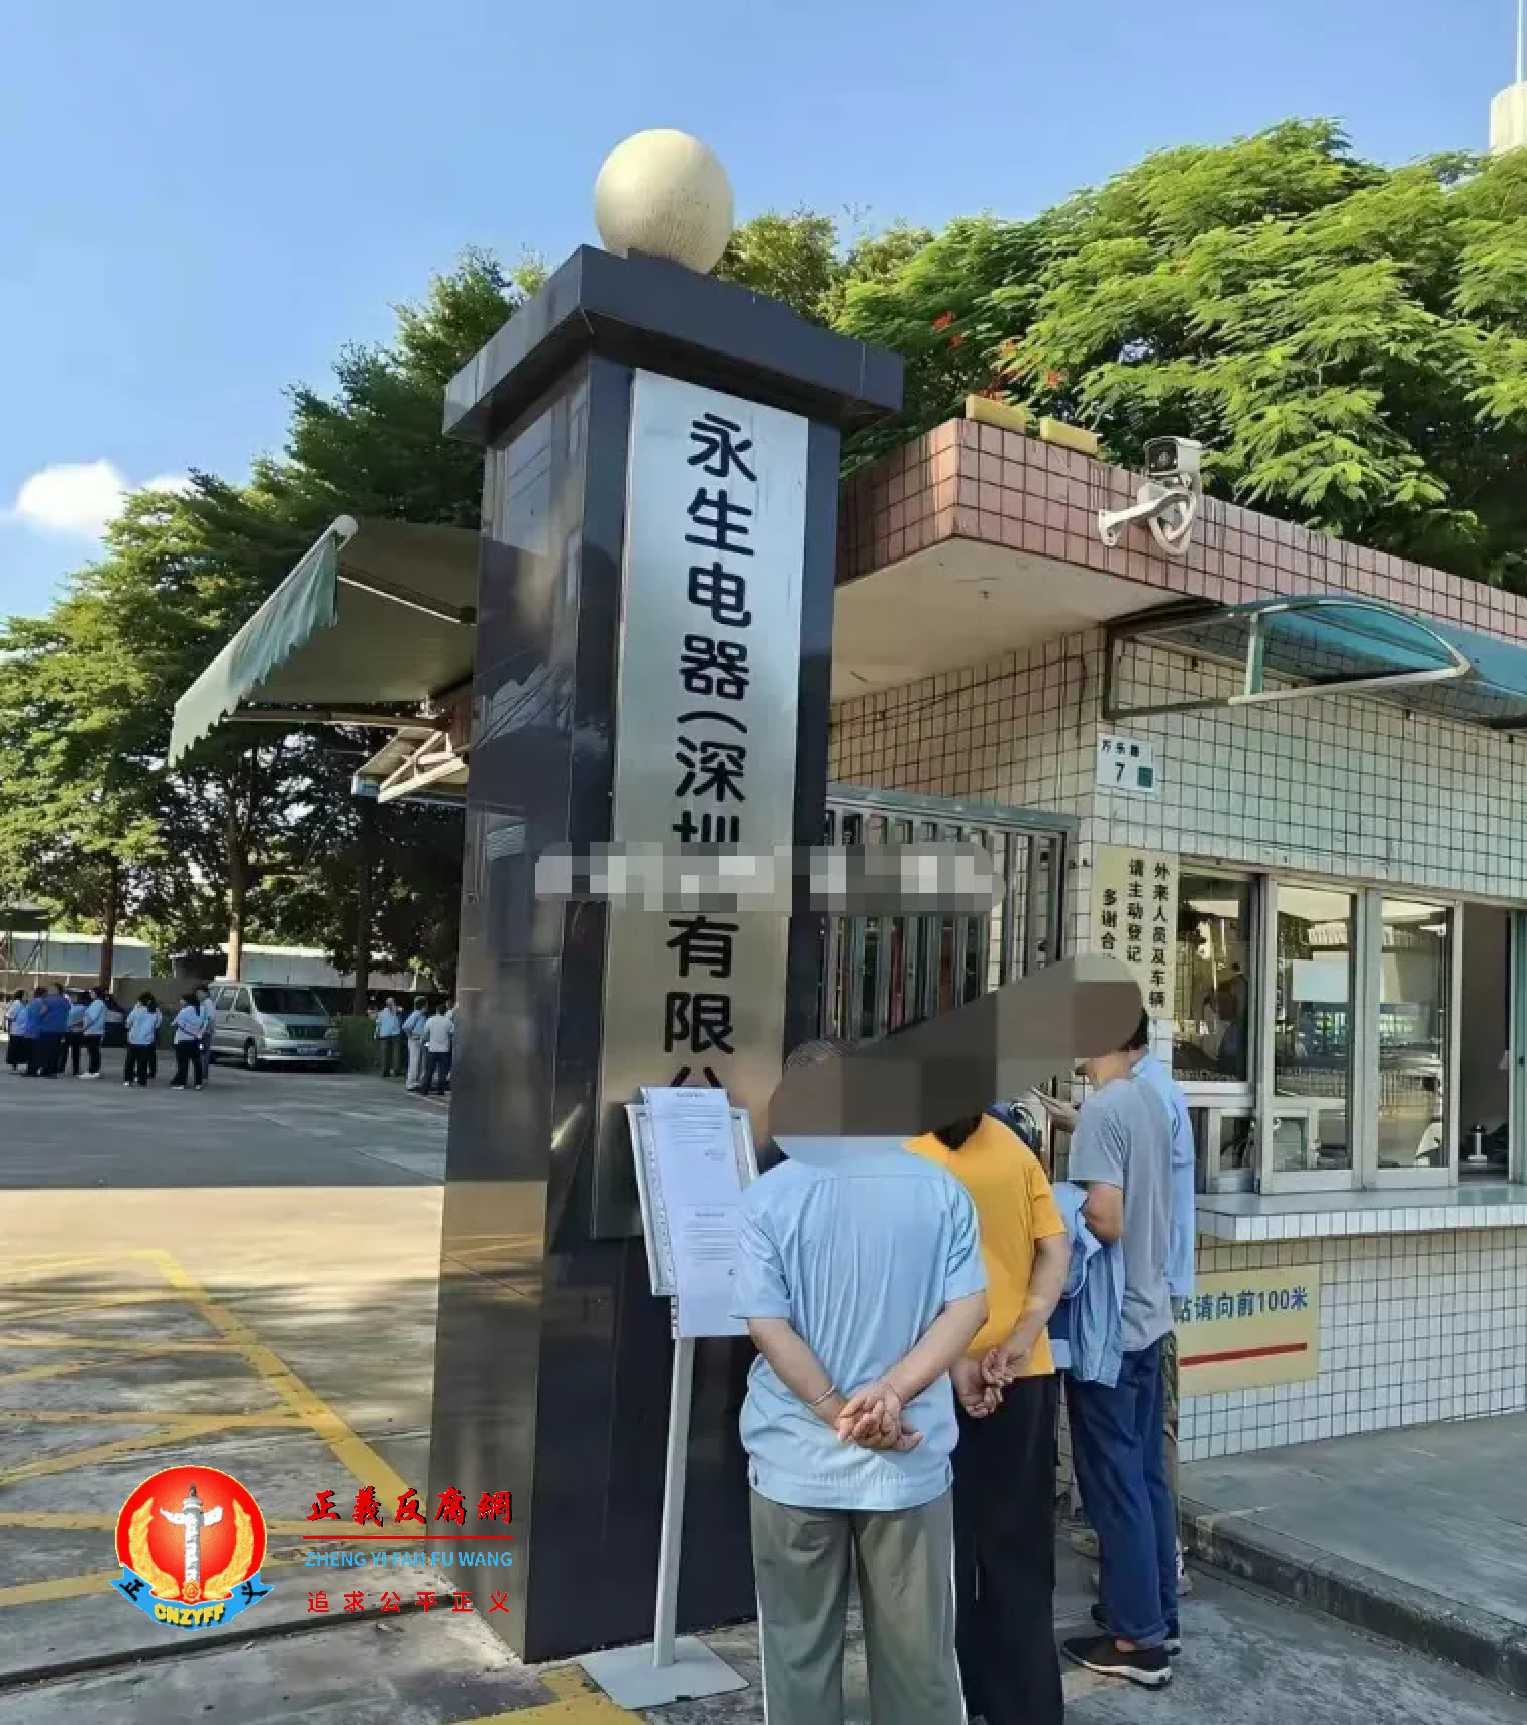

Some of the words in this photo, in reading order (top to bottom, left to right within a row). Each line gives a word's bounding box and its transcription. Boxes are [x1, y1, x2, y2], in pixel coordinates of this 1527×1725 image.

[1114, 761, 1126, 782] 7
[1149, 862, 1171, 1009] 外来人员及车辆
